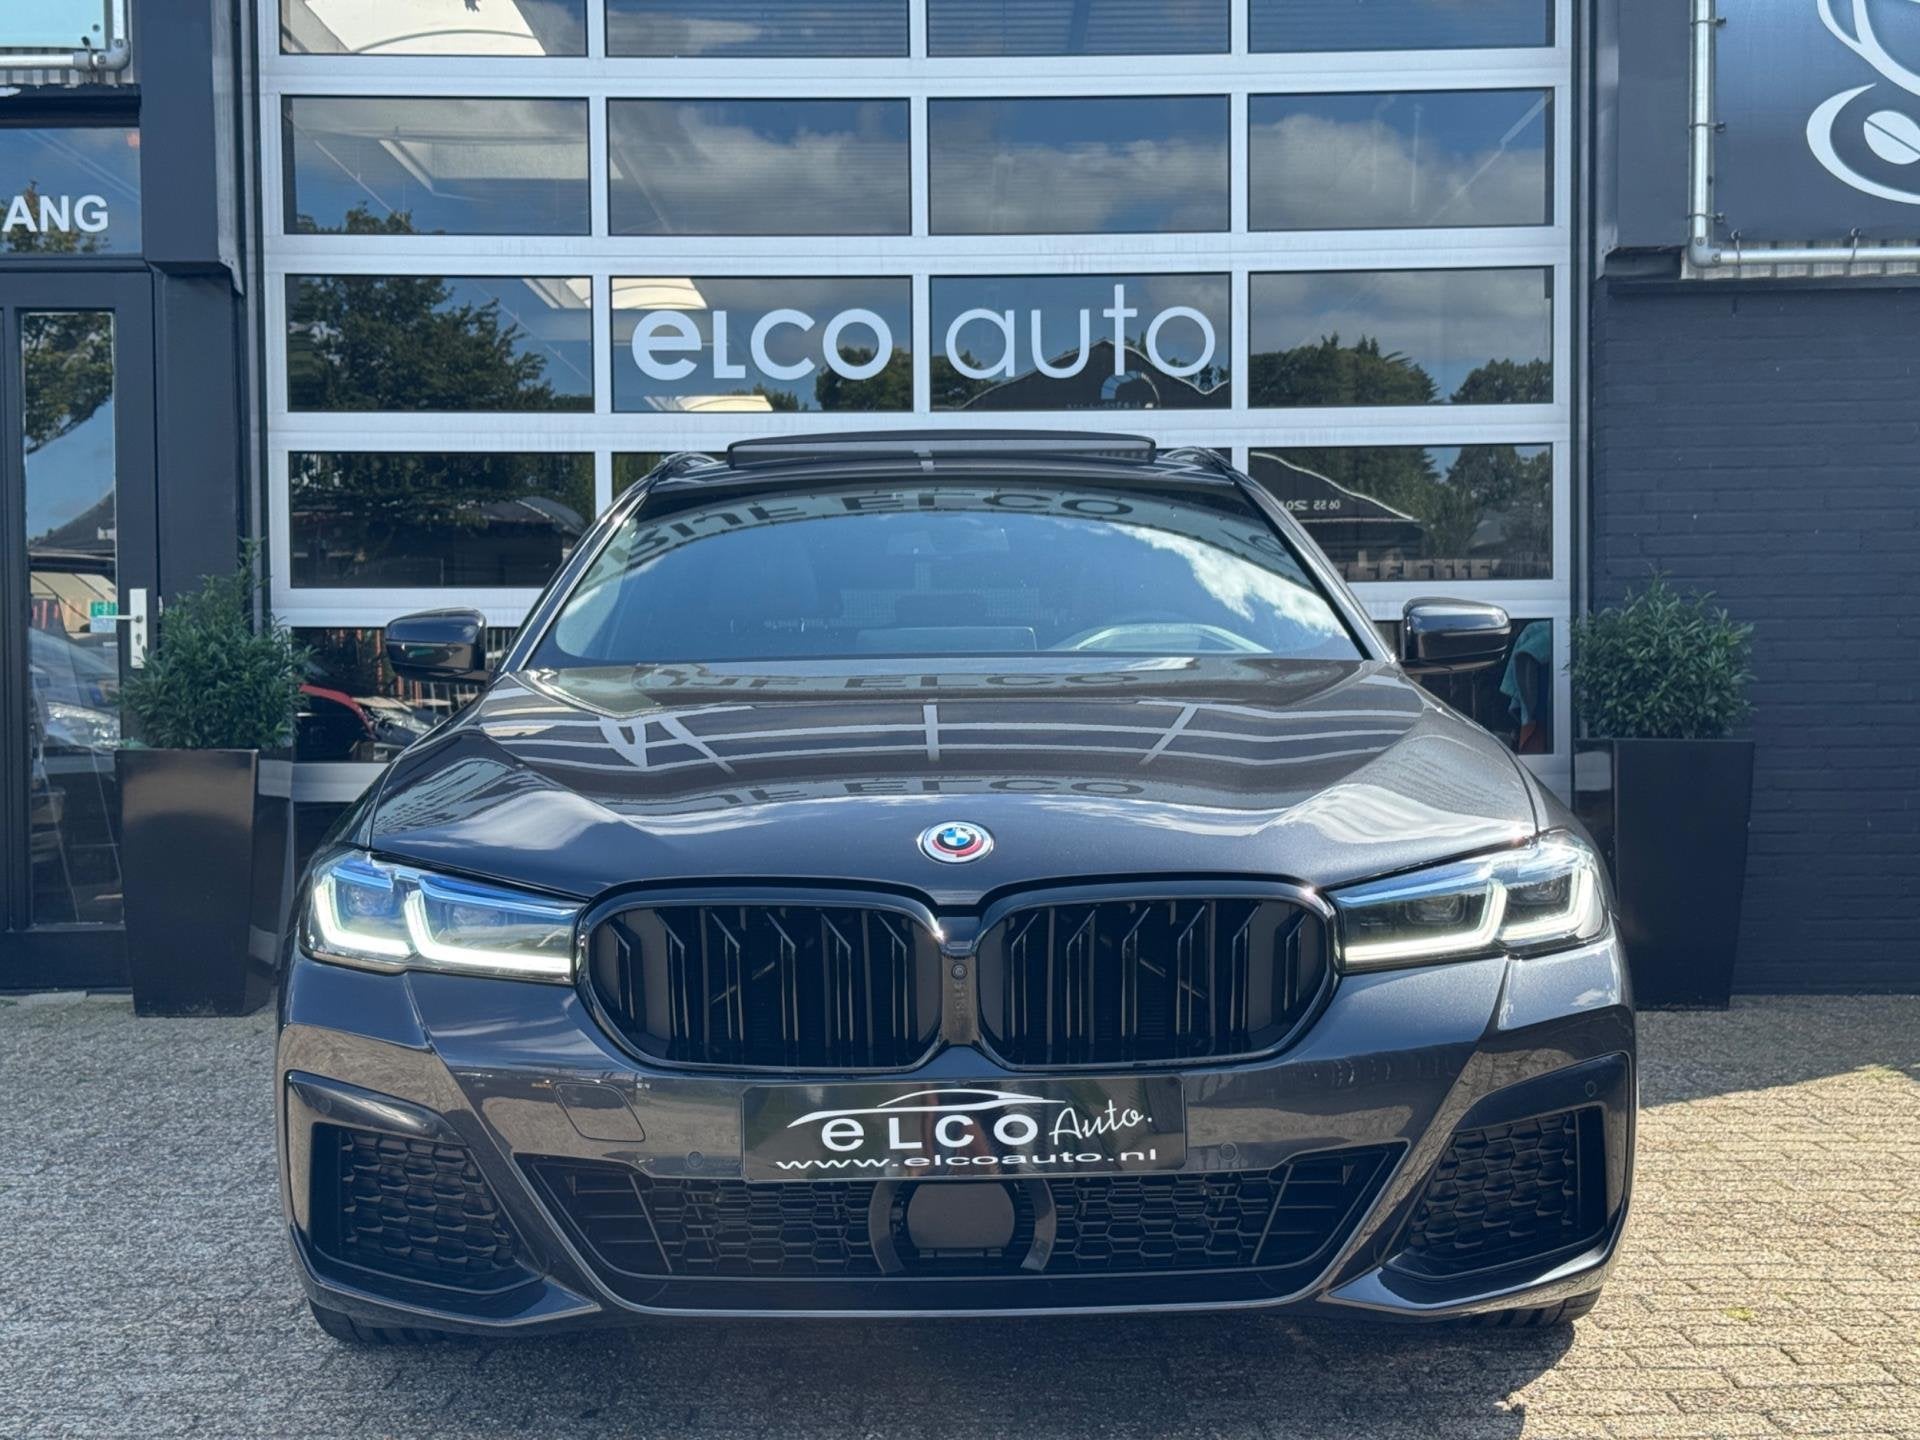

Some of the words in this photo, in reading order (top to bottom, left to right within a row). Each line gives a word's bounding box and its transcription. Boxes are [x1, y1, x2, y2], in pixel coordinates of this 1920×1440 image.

[2, 195, 109, 233] ANG
[945, 284, 1216, 379] auto
[775, 1148, 1157, 1170] www.elcoauto.nl
